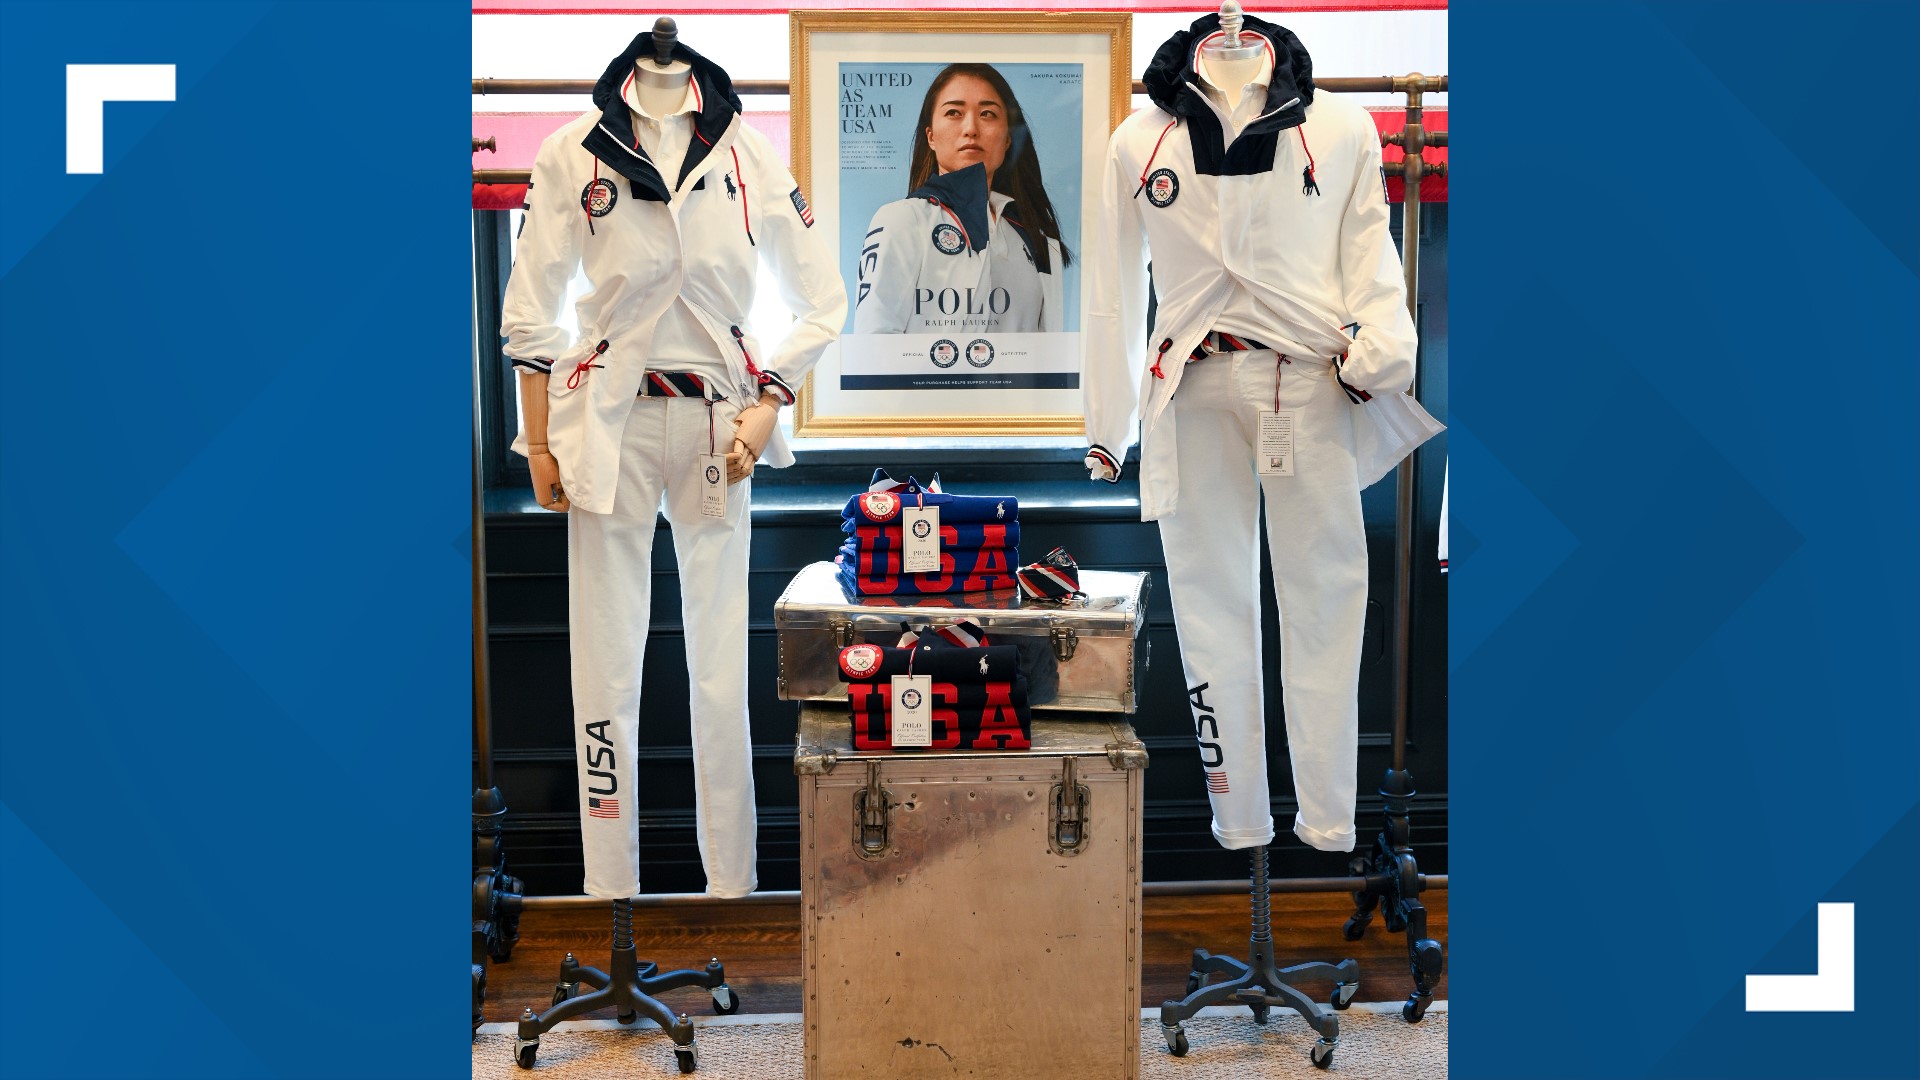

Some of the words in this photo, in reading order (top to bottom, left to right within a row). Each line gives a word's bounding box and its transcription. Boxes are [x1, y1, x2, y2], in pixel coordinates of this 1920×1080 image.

[841, 72, 913, 87] UNITED
[841, 88, 863, 102] AS
[841, 104, 892, 118] TEAM
[841, 119, 876, 134] USA
[914, 286, 1011, 316] POLO
[925, 319, 956, 327] RALPH
[962, 318, 1000, 327] LAUREN
[845, 666, 864, 676] OLYMPIC
[585, 719, 618, 796] USA
